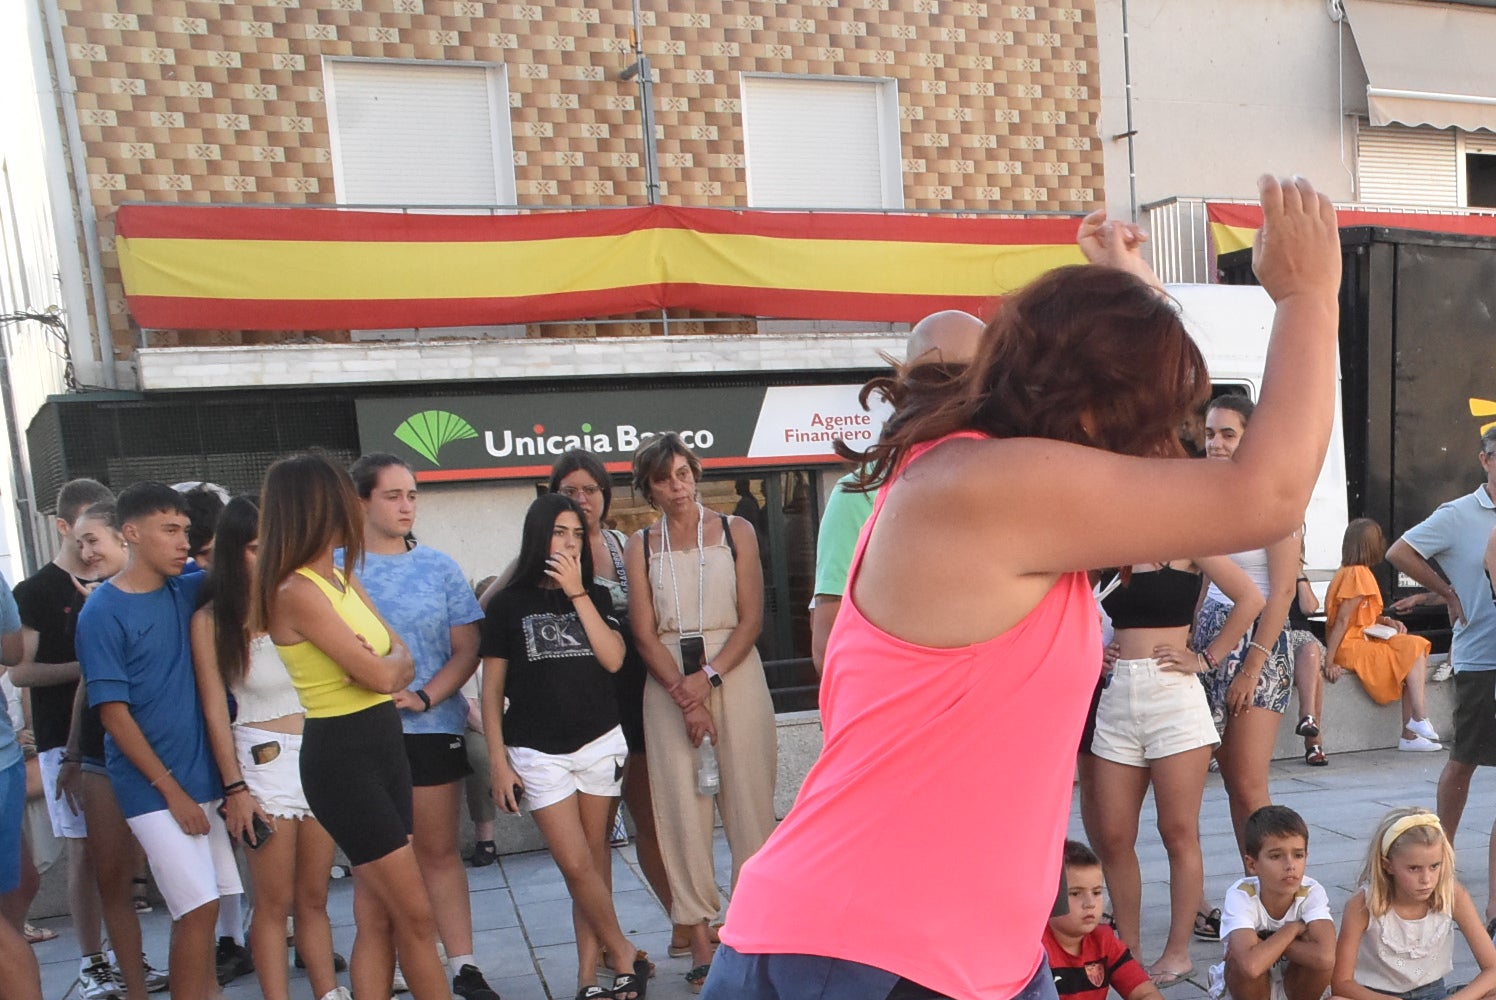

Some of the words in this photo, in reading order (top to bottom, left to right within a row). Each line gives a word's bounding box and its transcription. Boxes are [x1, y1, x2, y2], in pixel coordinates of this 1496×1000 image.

[811, 413, 871, 431] Agente
[484, 422, 613, 458] Unicaja
[616, 425, 714, 452] Bco
[784, 428, 872, 443] Financiero
